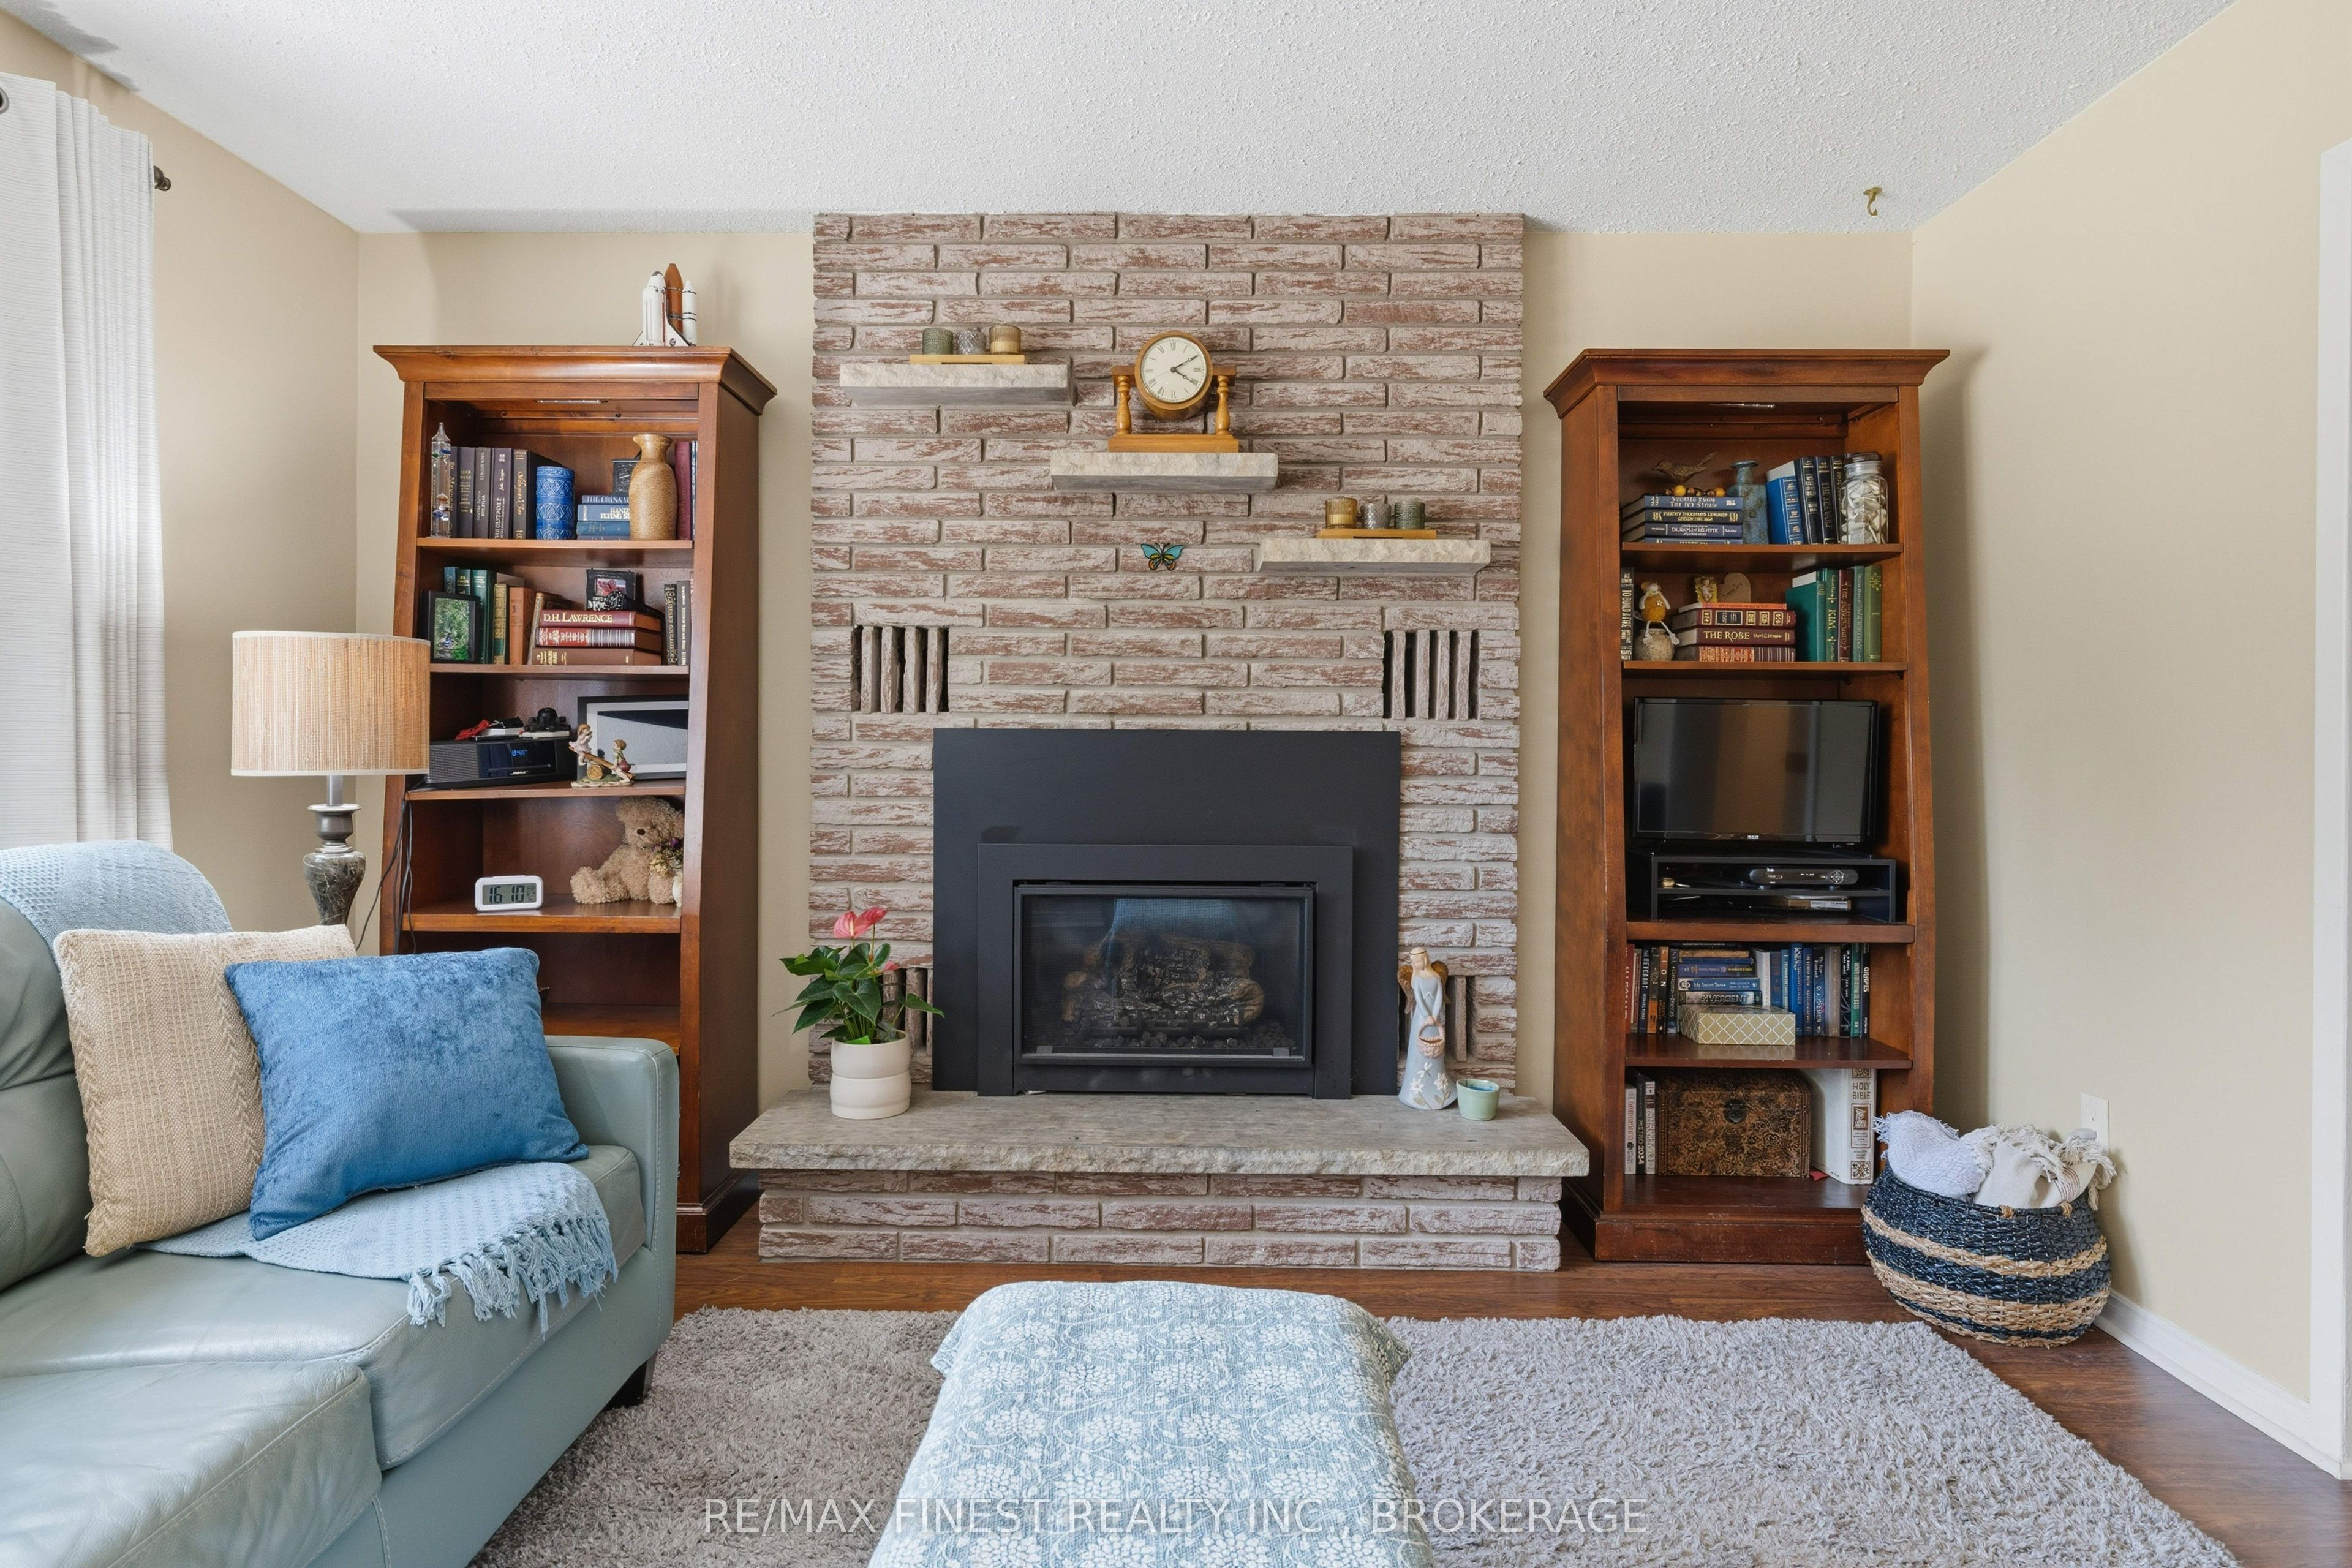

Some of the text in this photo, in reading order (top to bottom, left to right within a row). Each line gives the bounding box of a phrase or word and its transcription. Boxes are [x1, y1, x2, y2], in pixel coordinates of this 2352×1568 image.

[562, 612, 613, 623] LAWRENCE
[1725, 631, 1750, 642] ROBE
[1701, 994, 1747, 1003] DIVERGENT
[1852, 1082, 1871, 1091] HOLY
[1852, 1091, 1871, 1099] BIBLE
